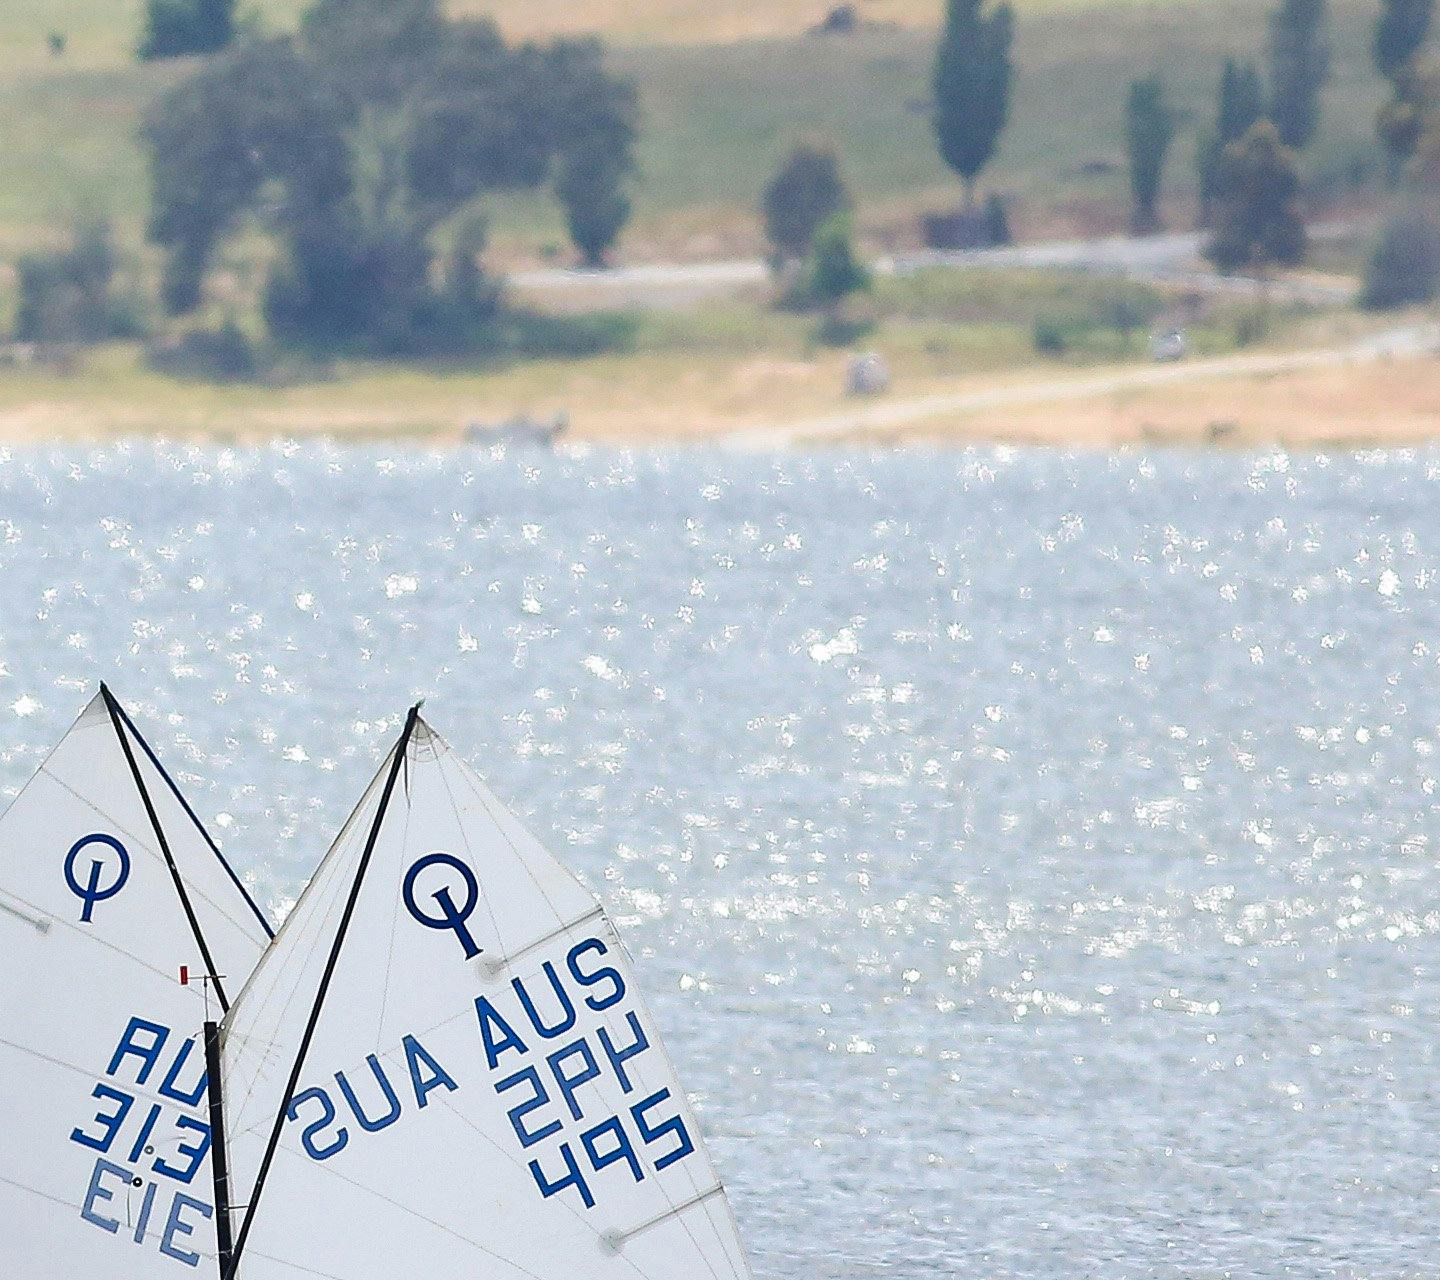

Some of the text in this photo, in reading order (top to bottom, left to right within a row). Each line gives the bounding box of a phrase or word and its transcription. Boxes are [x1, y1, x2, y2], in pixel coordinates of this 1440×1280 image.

[474, 937, 626, 1070] AUS
[70, 1083, 211, 1184] 313
[528, 1087, 695, 1210] 495
